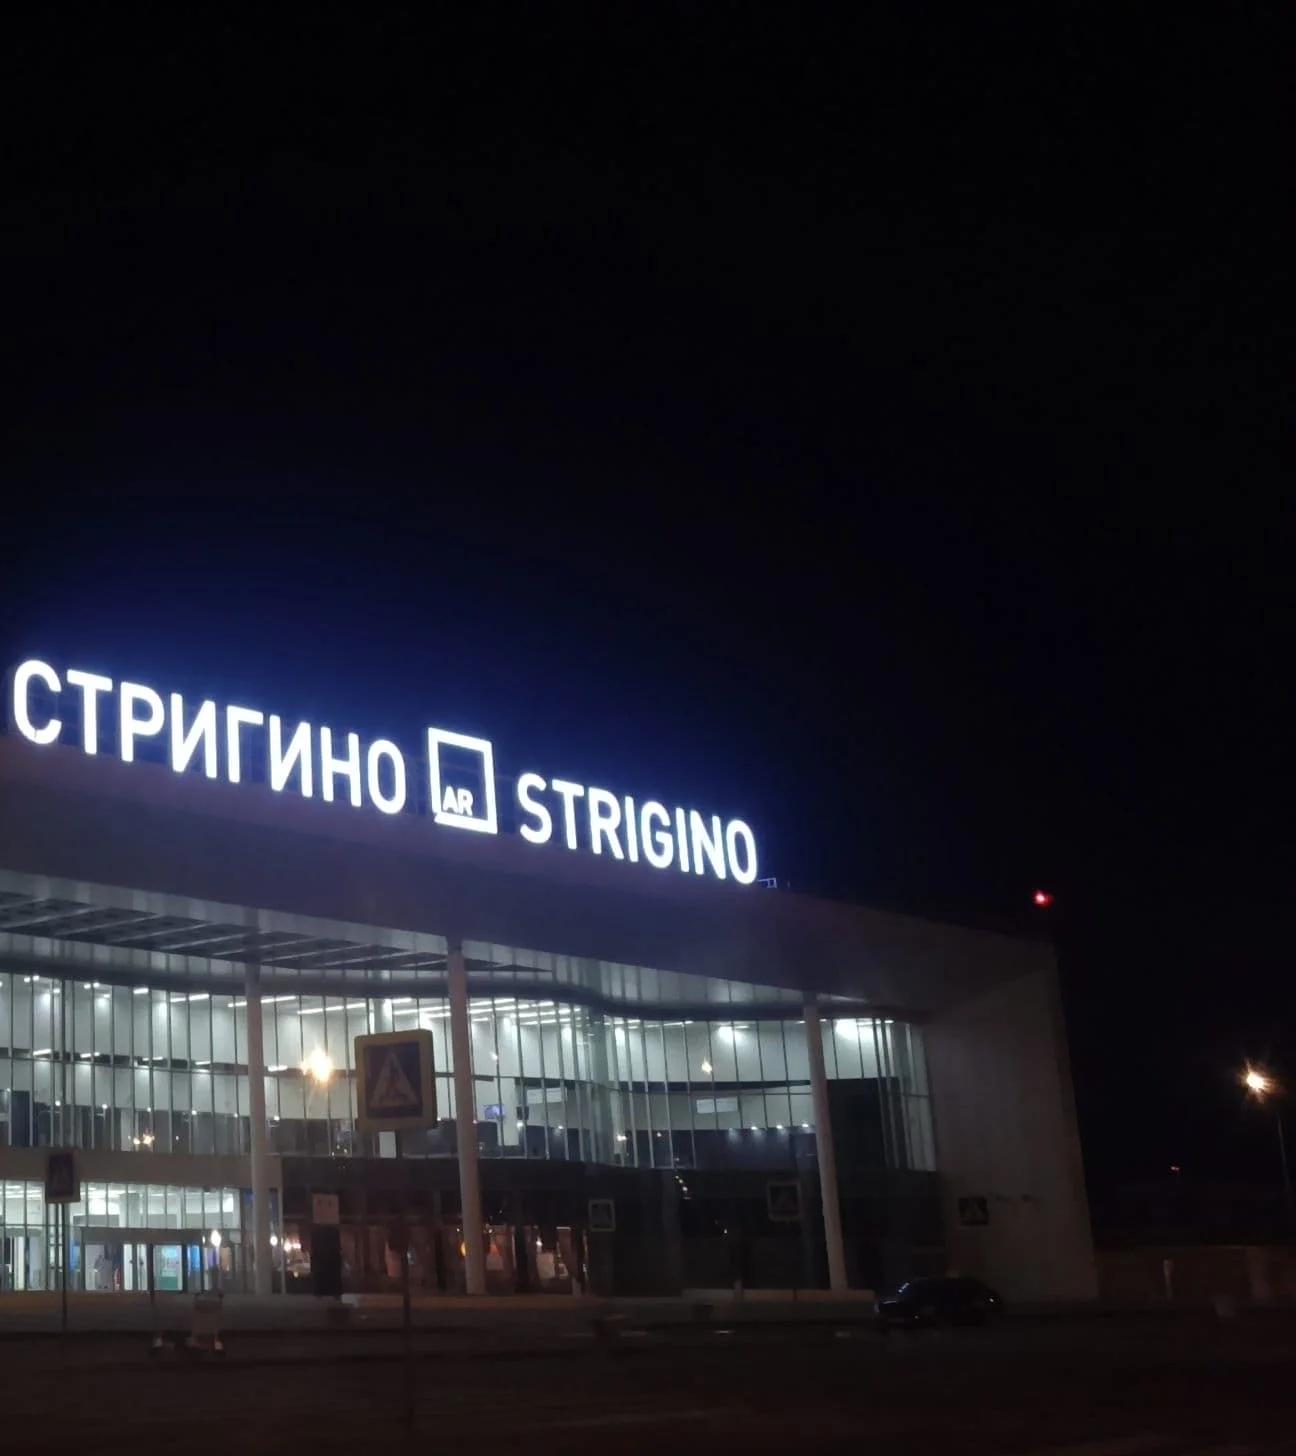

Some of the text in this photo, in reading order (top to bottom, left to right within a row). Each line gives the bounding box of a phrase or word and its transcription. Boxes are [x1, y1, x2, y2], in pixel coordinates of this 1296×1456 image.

[13, 659, 406, 814] СТРИГИНО
[442, 785, 474, 817] AR
[517, 772, 758, 884] STRIGINO
